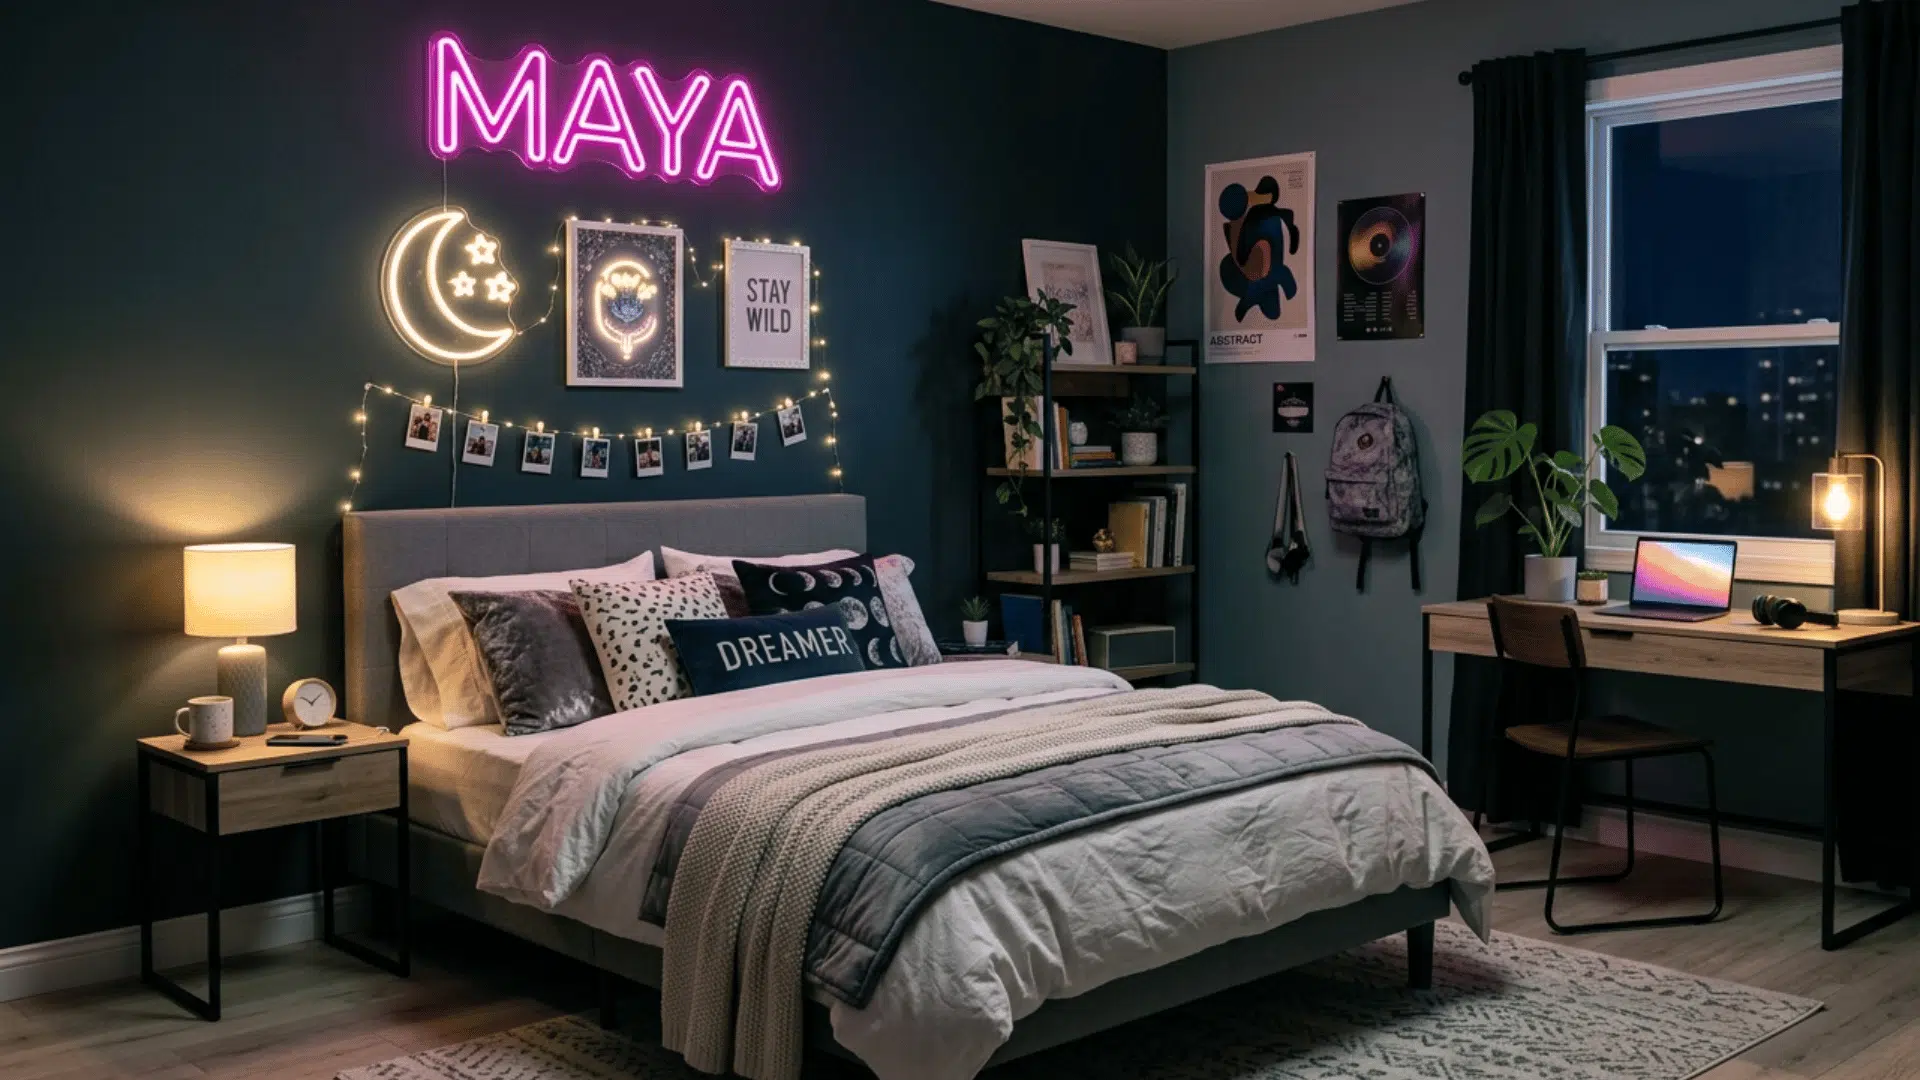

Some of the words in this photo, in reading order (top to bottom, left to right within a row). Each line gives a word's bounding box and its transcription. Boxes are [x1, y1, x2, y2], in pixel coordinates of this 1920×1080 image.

[436, 36, 781, 187] MAYA
[747, 278, 791, 304] STAY
[746, 307, 791, 333] WILD
[1209, 333, 1263, 346] ABSTRACT
[716, 625, 854, 672] DREAMER
